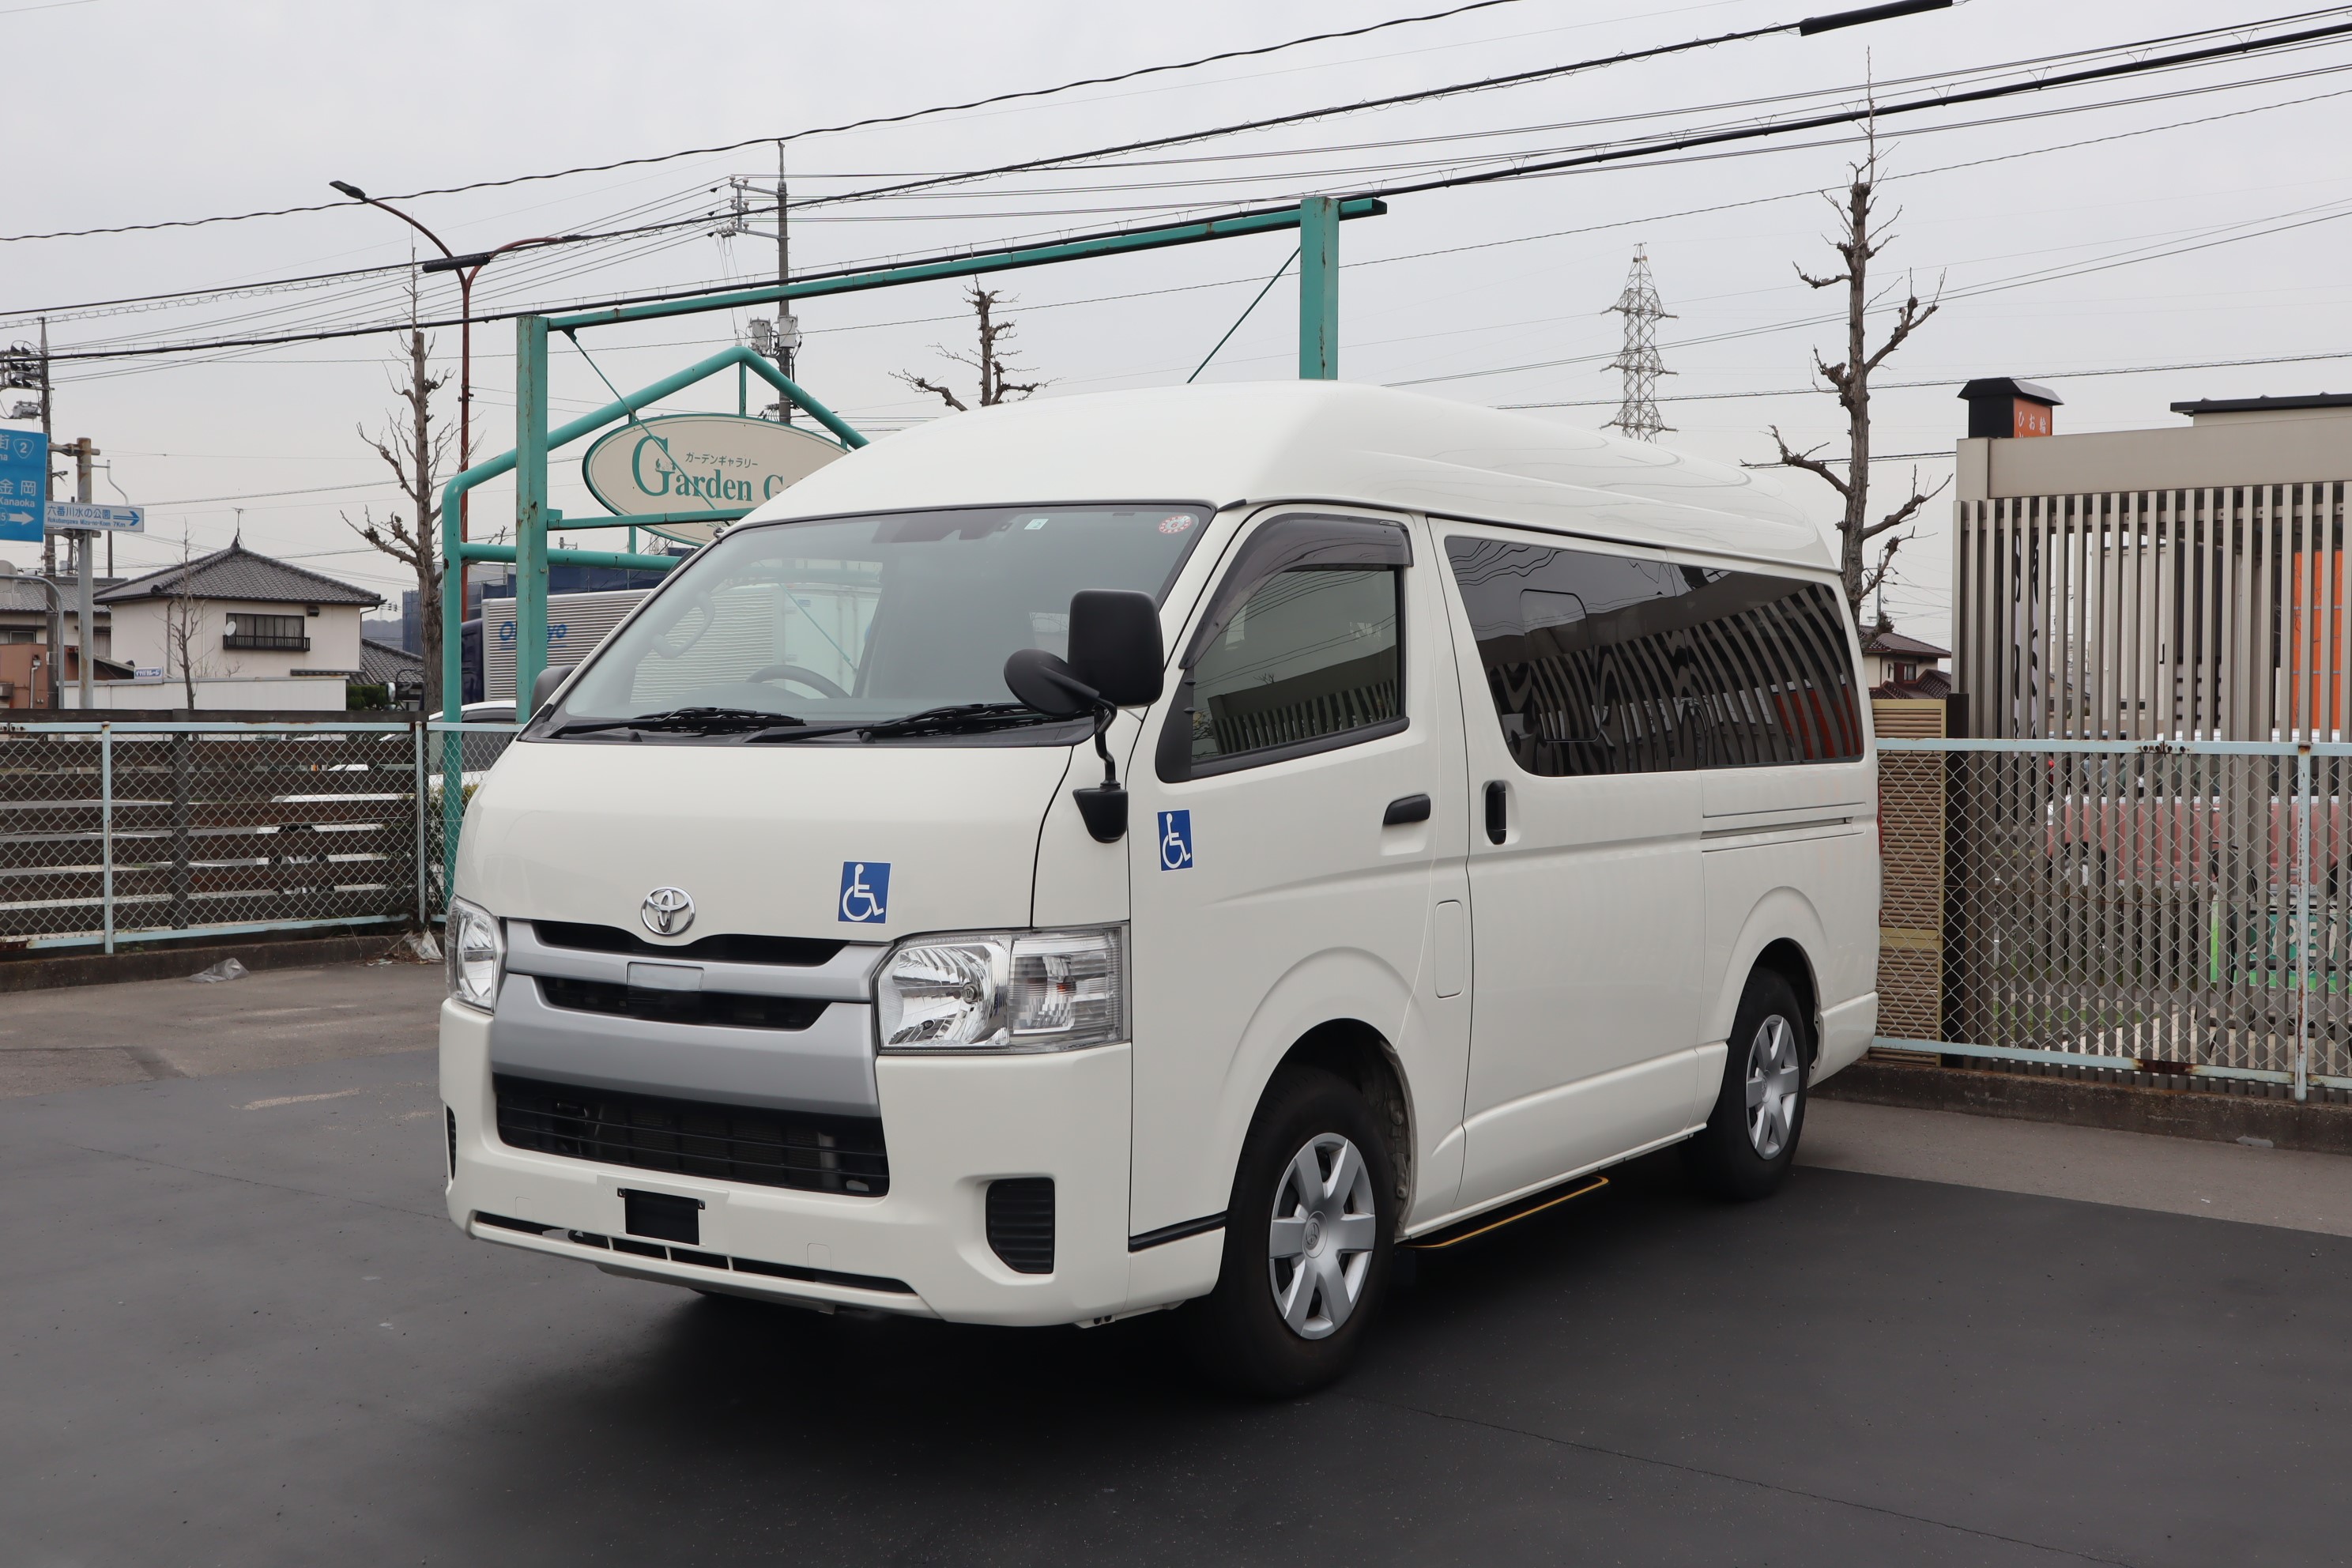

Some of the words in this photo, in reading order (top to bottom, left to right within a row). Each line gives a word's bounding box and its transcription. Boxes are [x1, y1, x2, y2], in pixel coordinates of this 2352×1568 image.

[20, 442, 27, 454] 2
[684, 451, 759, 469] ガーデンギャラリー
[631, 435, 753, 502] Garden
[0, 479, 36, 496] 金岡
[0, 496, 36, 507] Kanaoka
[47, 506, 111, 520] 六番川水の公園
